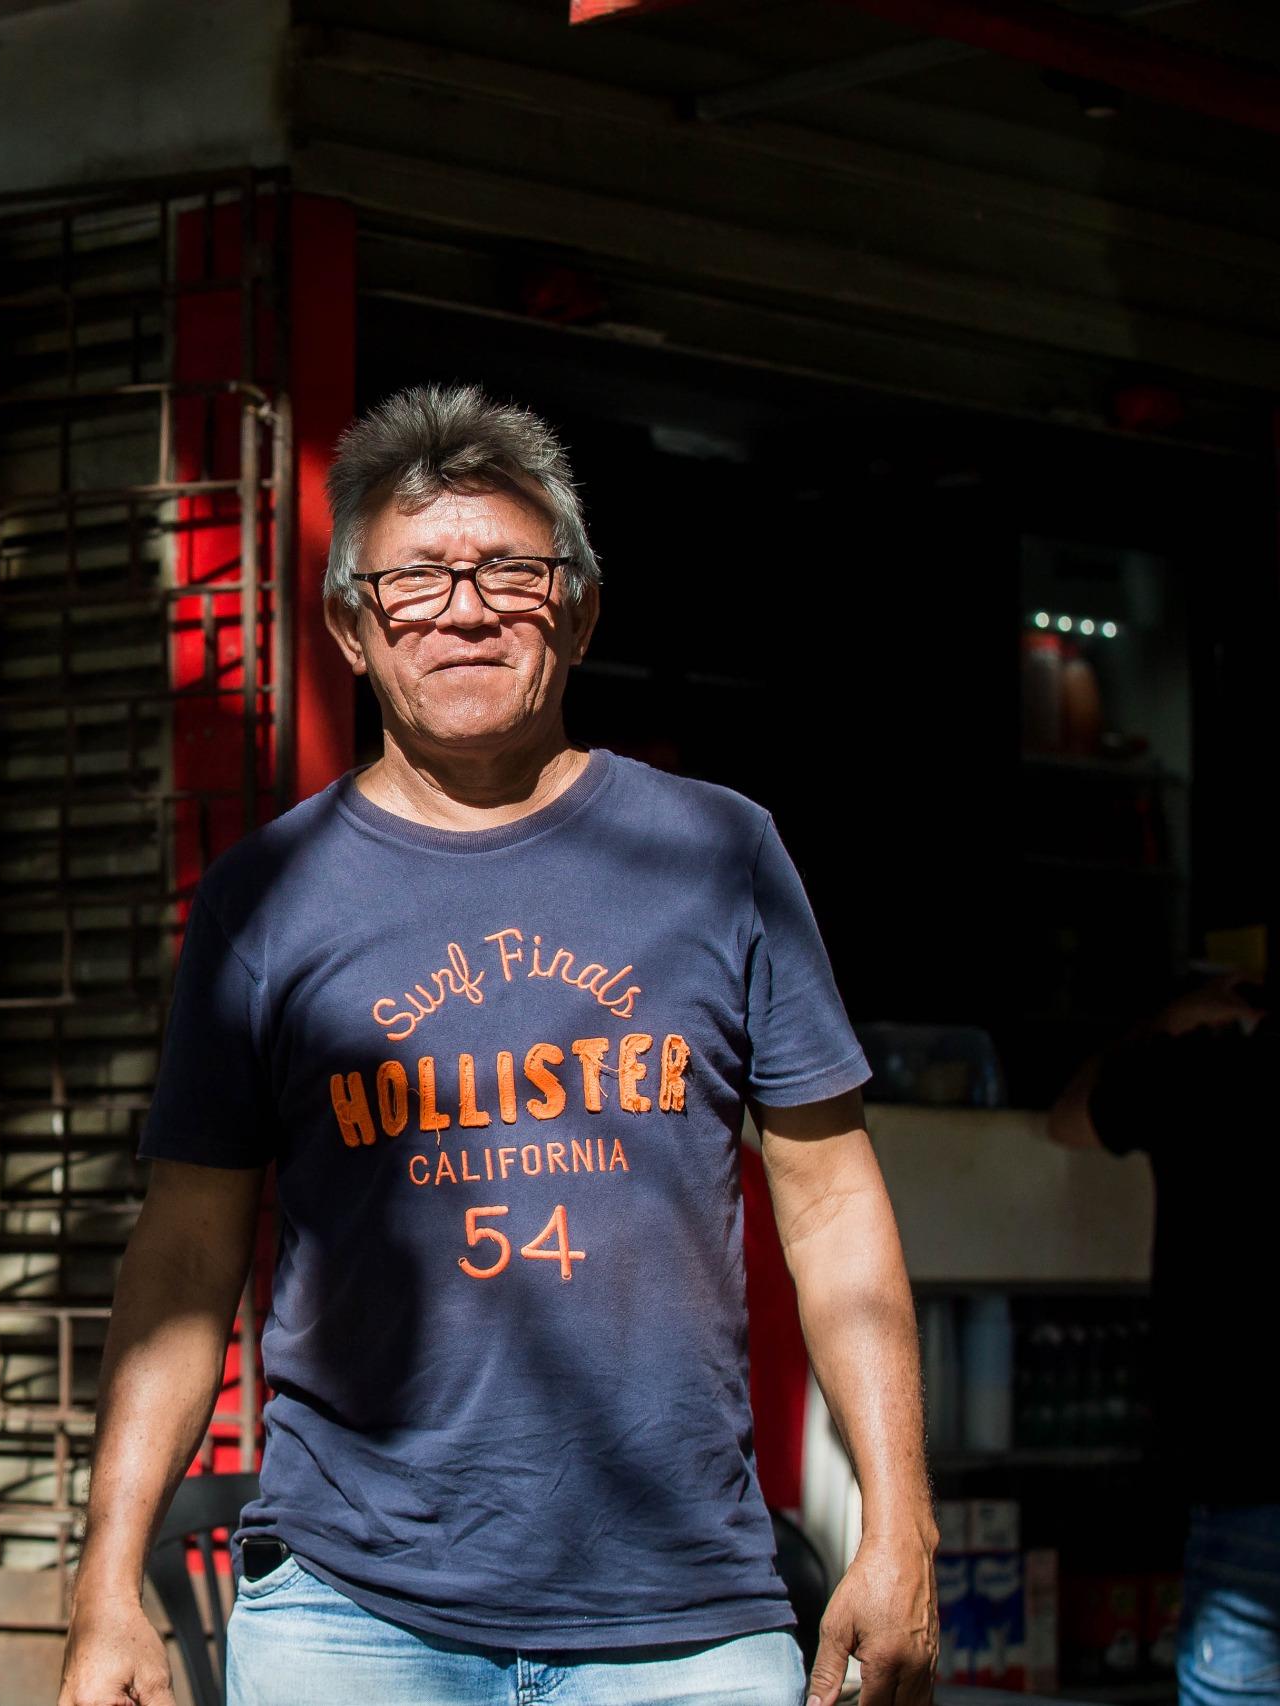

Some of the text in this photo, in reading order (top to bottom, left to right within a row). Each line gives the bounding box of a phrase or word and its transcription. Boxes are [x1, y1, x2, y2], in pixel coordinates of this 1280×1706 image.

[372, 928, 642, 1041] Surf Finals
[329, 1033, 691, 1148] HOLLISTER
[408, 1138, 630, 1186] CALIFORNIA
[457, 1203, 587, 1281] 54
